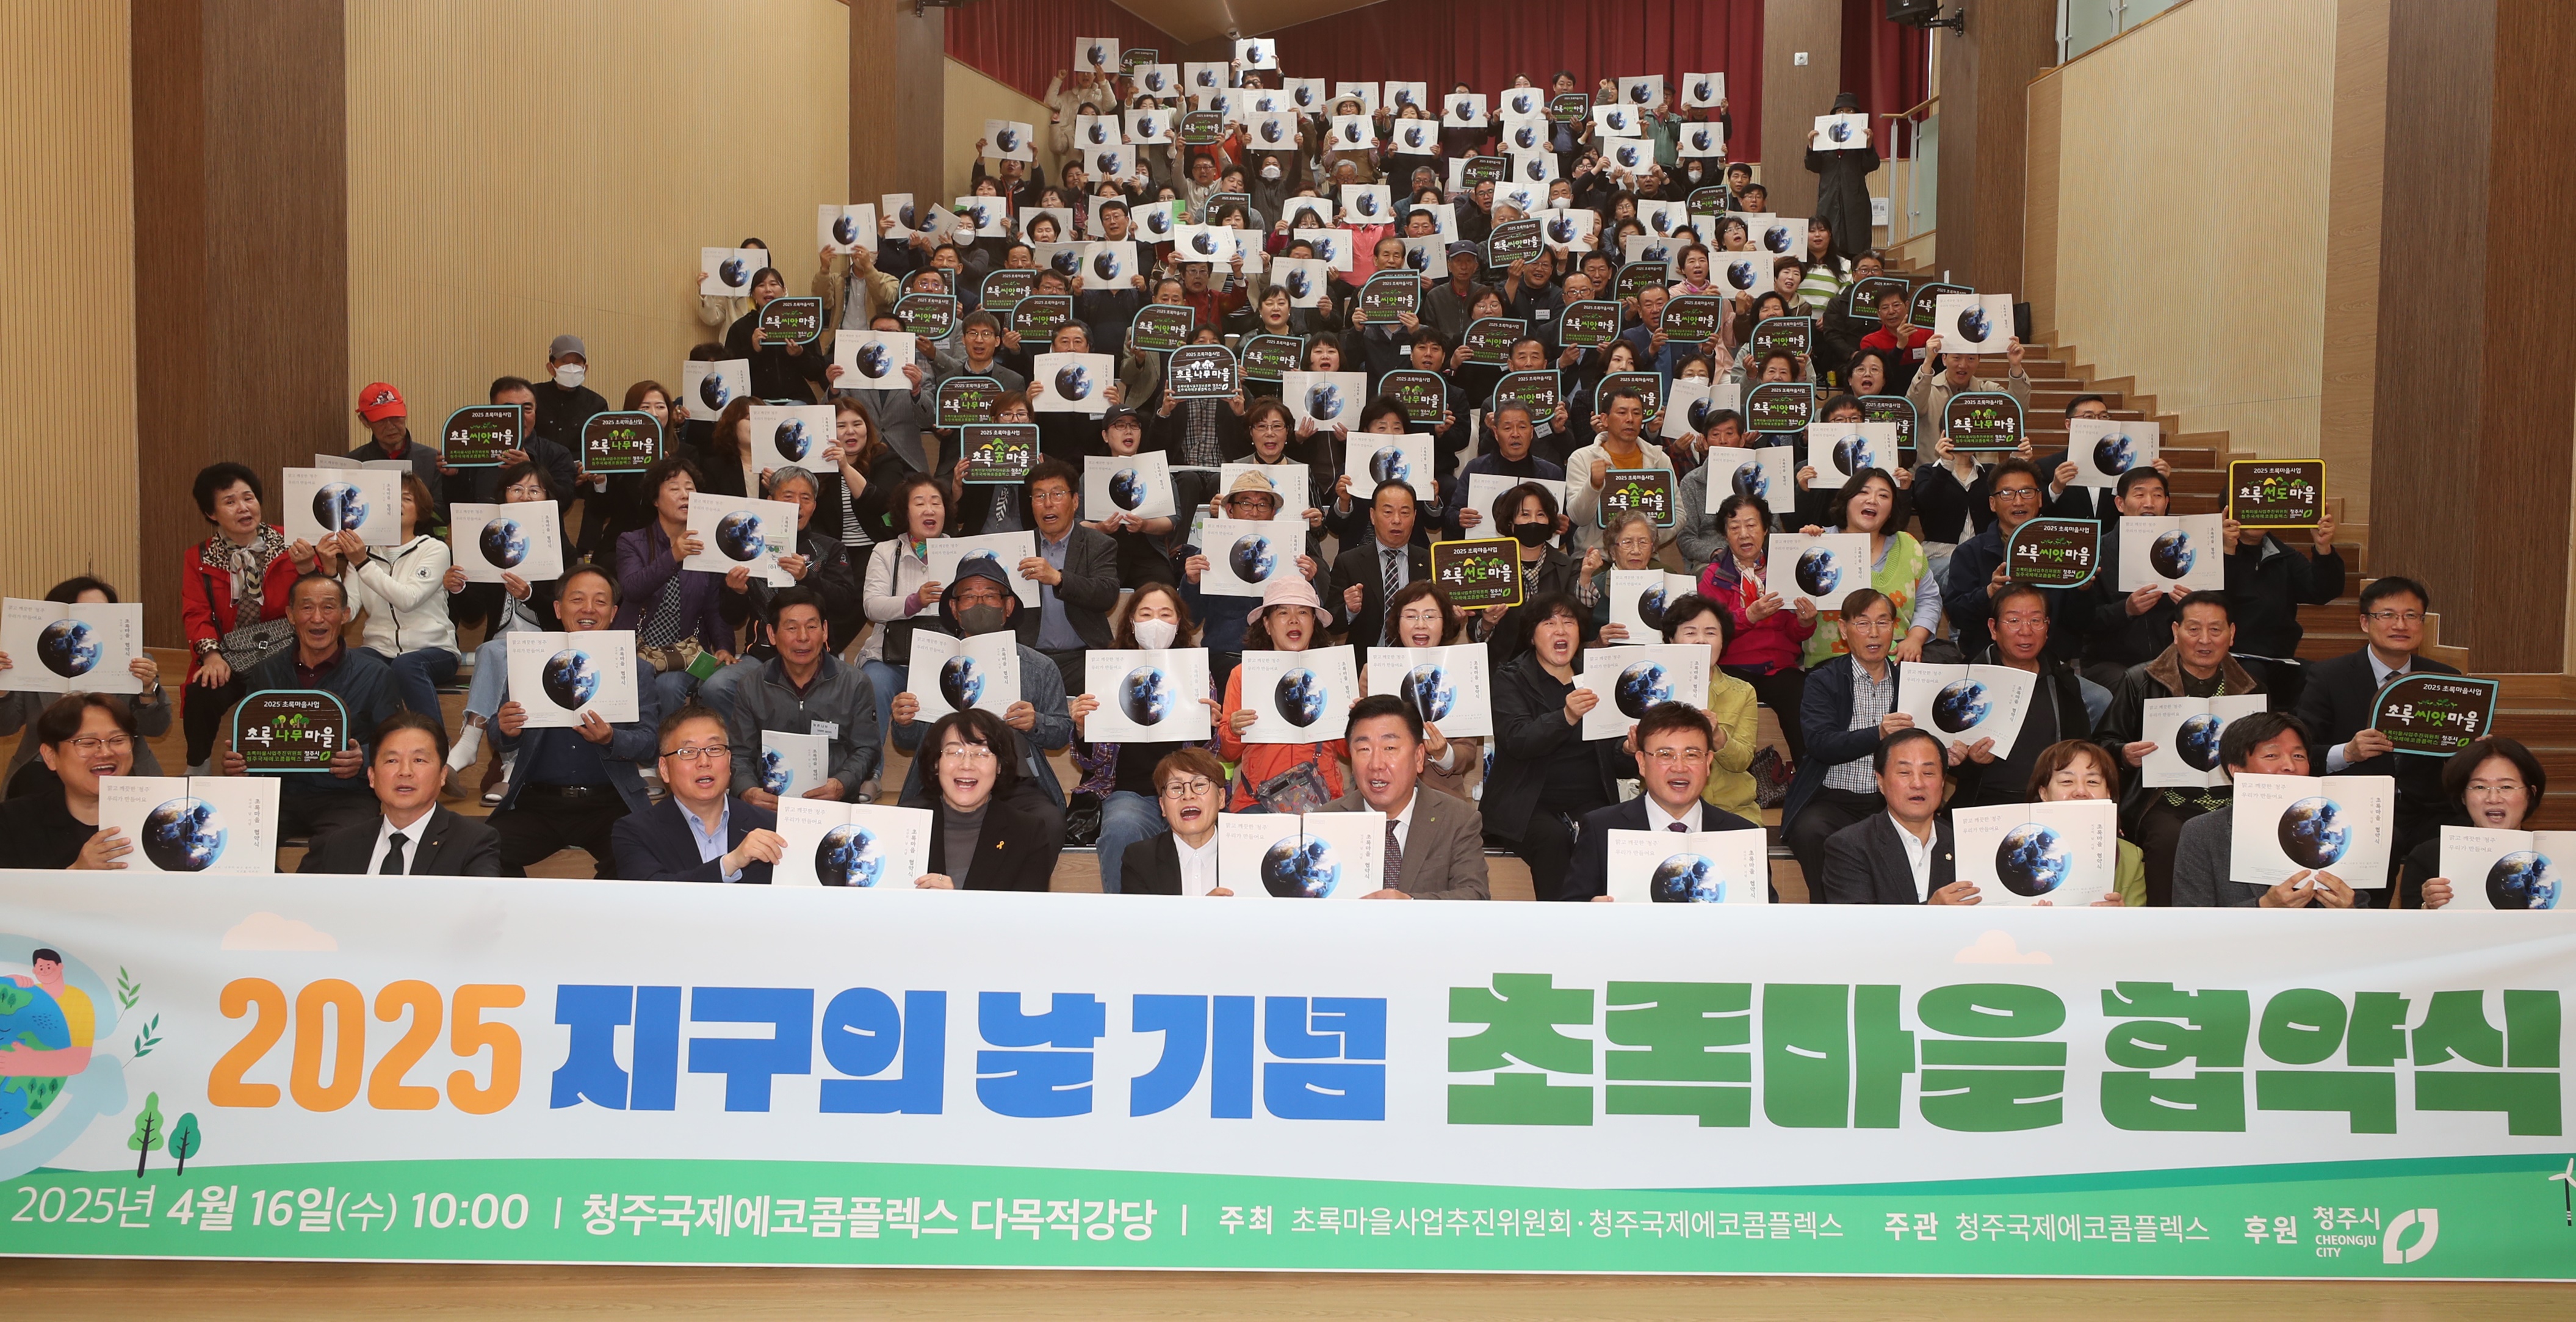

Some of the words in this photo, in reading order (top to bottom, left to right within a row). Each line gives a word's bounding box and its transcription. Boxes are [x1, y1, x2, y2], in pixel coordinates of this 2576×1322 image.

[2436, 685, 2482, 696] 초록마을사업
[281, 700, 320, 709] 초록마을사업
[2387, 735, 2438, 745] 주국제에코콤플렉스
[207, 977, 526, 1115] 2025
[549, 984, 947, 1115] 지구의
[975, 991, 1106, 1118] 날
[1129, 994, 1387, 1122] 기념
[1447, 972, 2068, 1132] 초록마을
[2099, 981, 2563, 1137] 협약식
[11, 1185, 155, 1230] 2025년
[166, 1185, 237, 1231] 4월
[250, 1187, 397, 1232] 16일(수)
[411, 1192, 529, 1230] 10:00
[582, 1194, 959, 1239] 청주국제에코콤플렉스
[970, 1196, 1157, 1241] 다목적강당
[1219, 1204, 1273, 1236] 주최
[1885, 1211, 1938, 1242] 주관
[1955, 1213, 2210, 1243] 청주국제에코콤플렉스
[2244, 1215, 2297, 1244] 후원
[2313, 1206, 2380, 1231] 청주시
[2315, 1235, 2376, 1248] CHEONGJU
[2315, 1248, 2341, 1257] CITY
